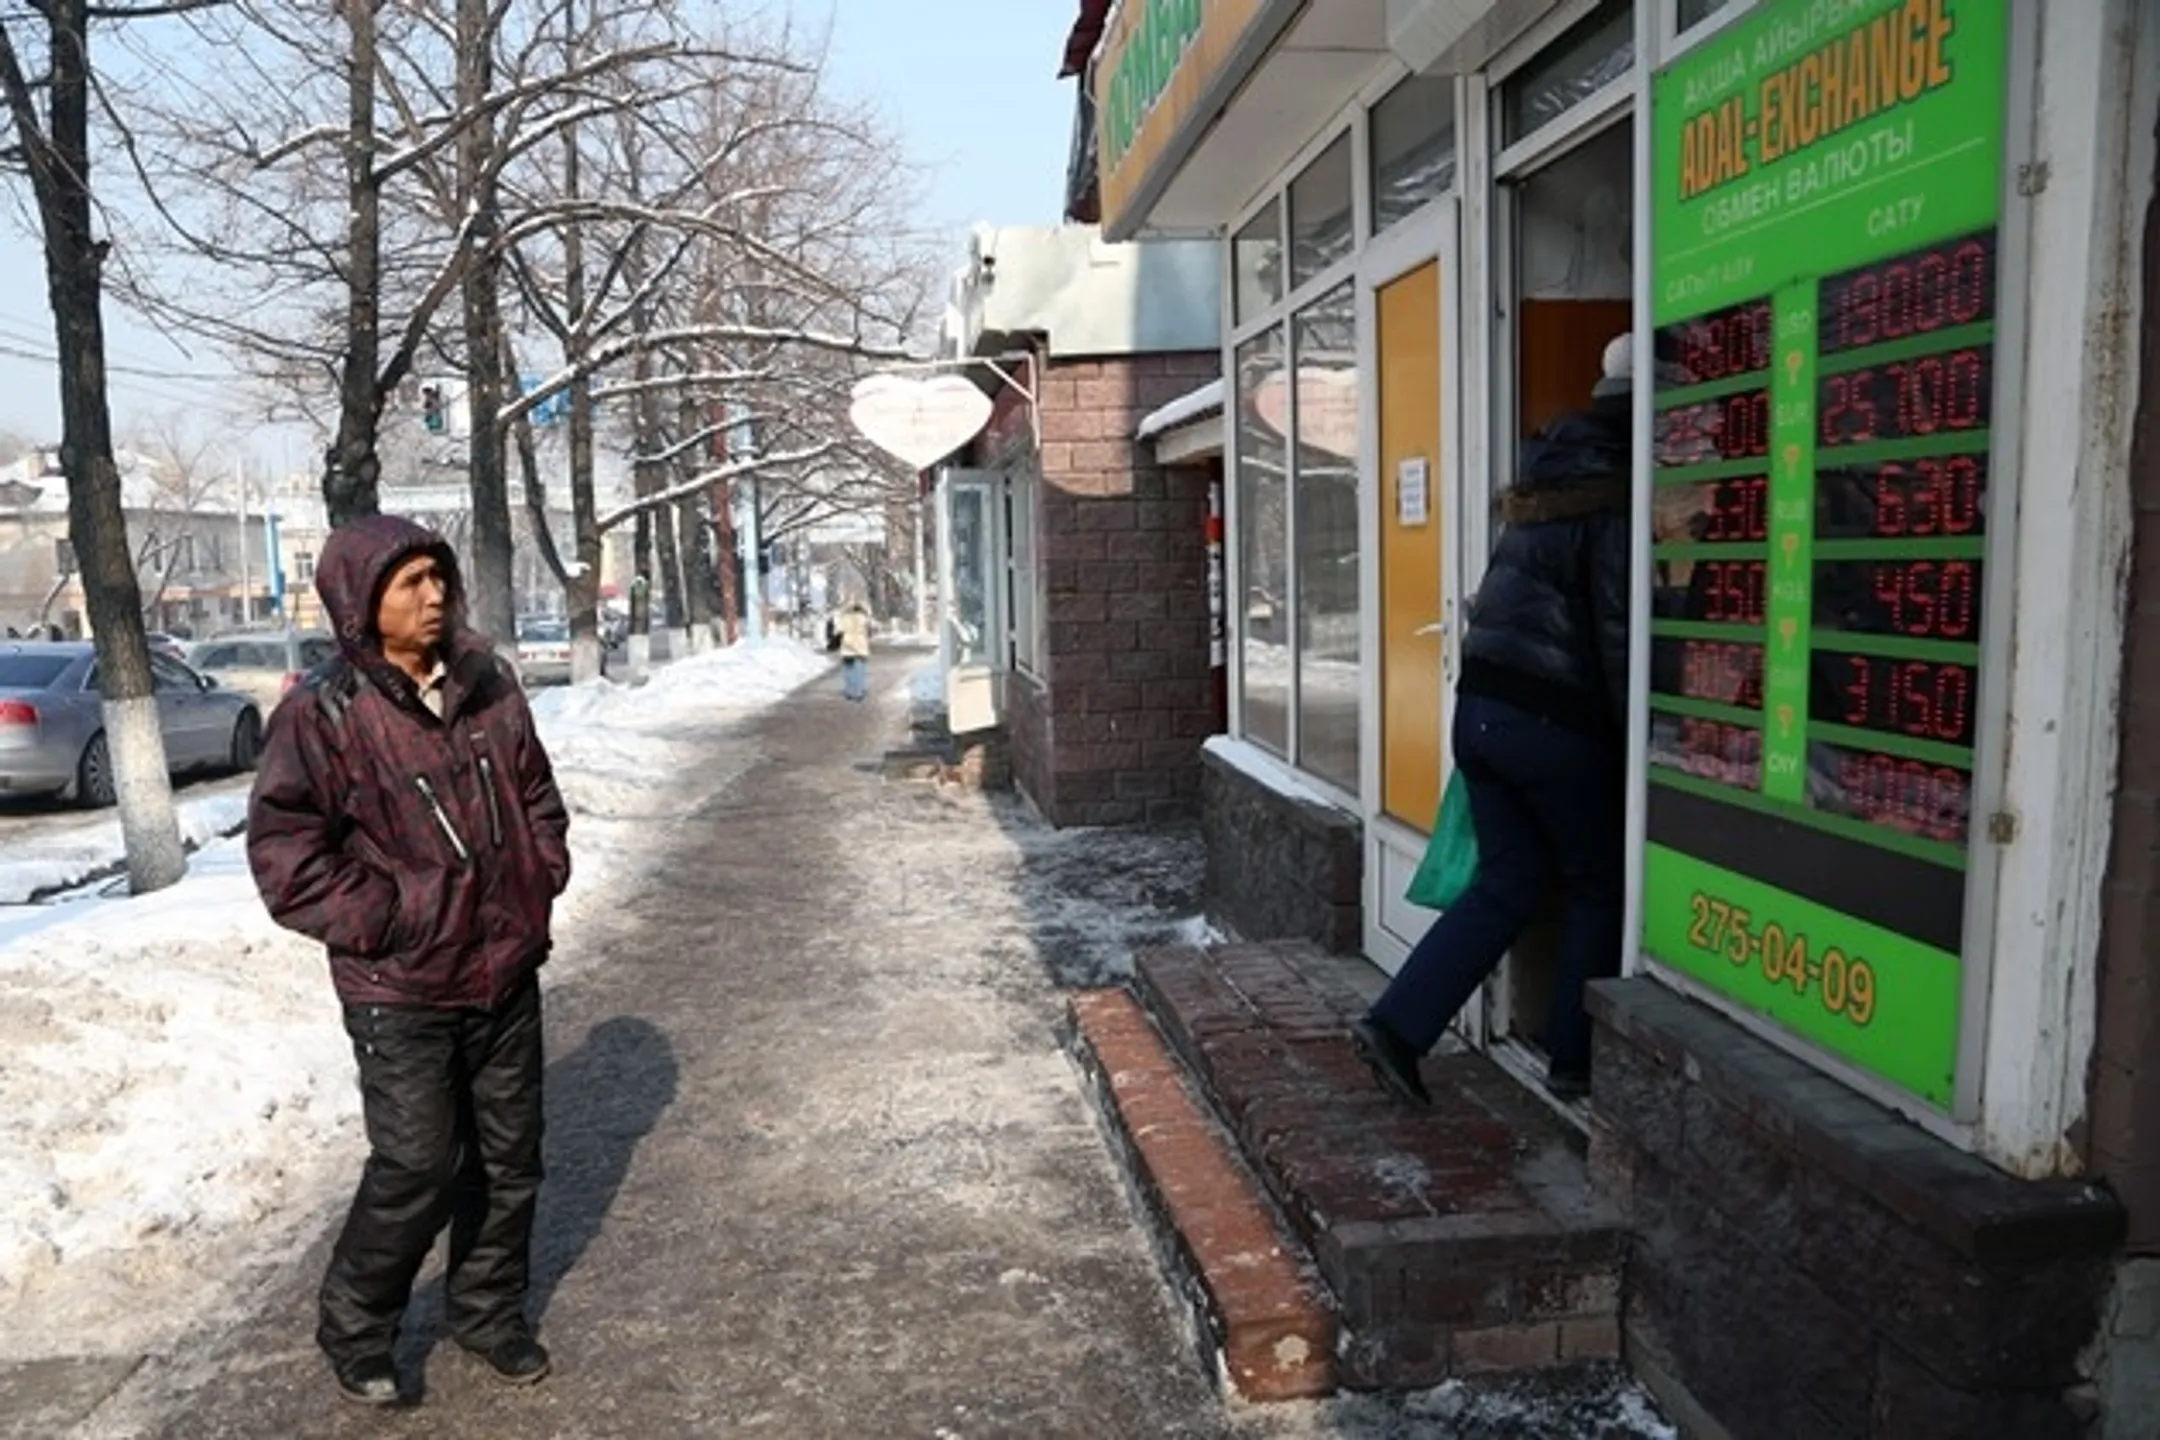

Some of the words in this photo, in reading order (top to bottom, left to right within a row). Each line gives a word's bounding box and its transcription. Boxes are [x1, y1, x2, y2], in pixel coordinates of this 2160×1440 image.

[1680, 0, 1951, 203] ADAL-EXCHANGE
[1702, 176, 1780, 236] ОБМЕН
[1785, 117, 1915, 202] ВАЛЮТЫ
[1867, 193, 1925, 237] САТУ
[1689, 892, 1875, 1028] 275-04-09
